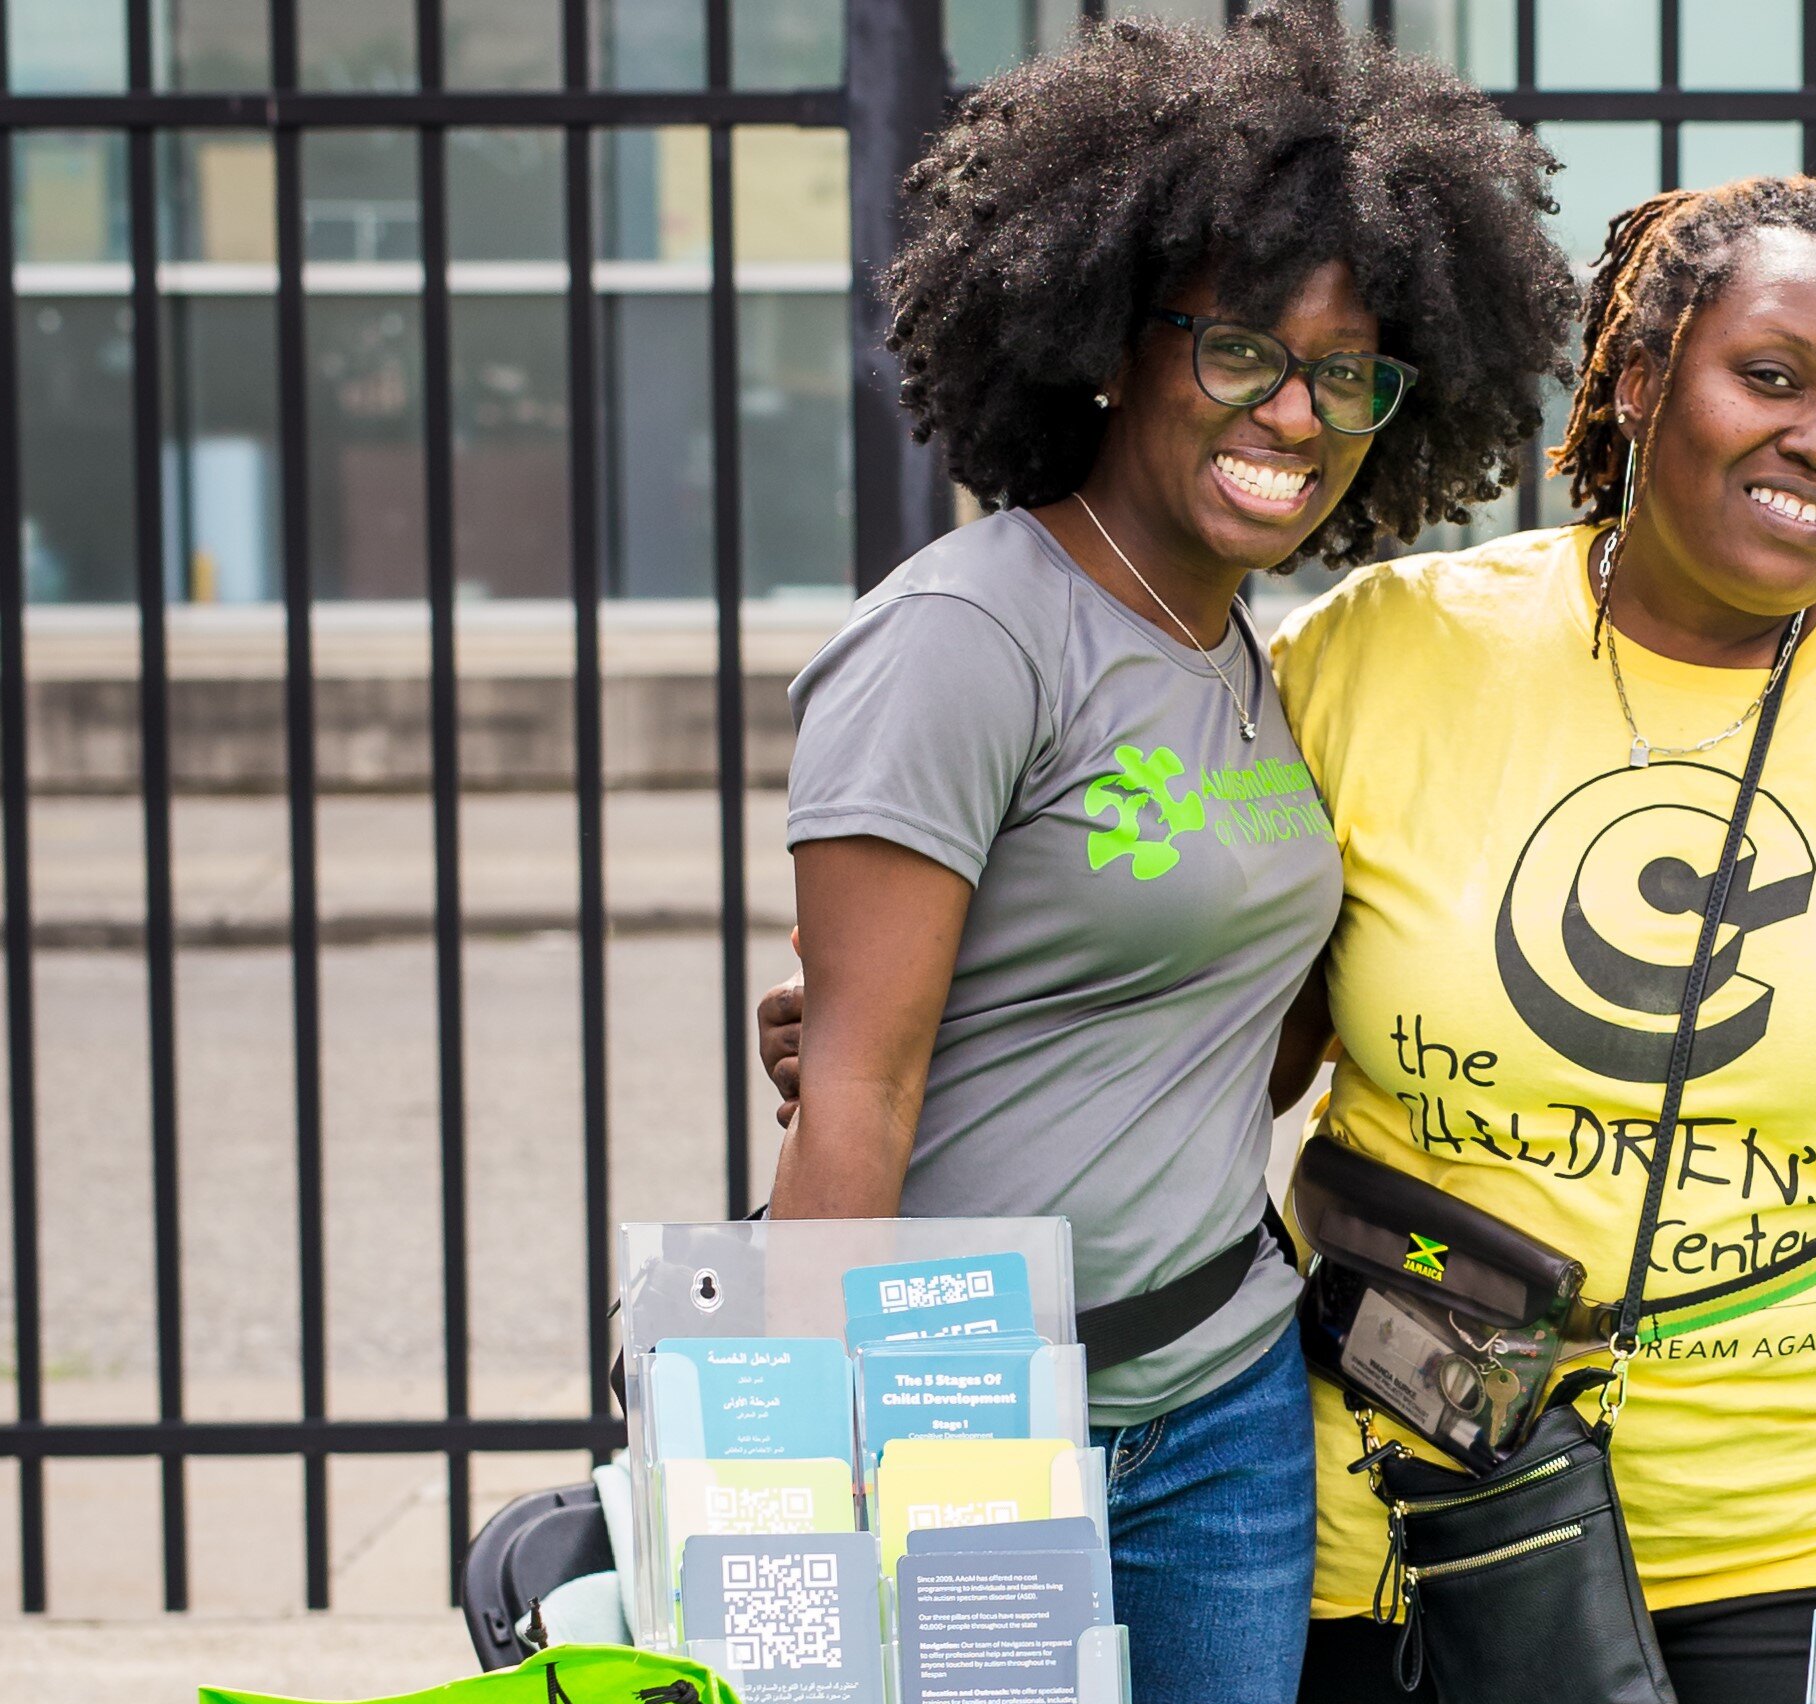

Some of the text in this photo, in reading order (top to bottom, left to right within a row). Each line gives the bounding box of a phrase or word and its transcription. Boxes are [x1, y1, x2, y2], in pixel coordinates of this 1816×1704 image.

[1390, 1014, 1498, 1087] the
[1403, 1258, 1443, 1283] JAMAICA
[1640, 1338, 1739, 1360] REAM
[894, 1373, 1002, 1389] The 5 Stages Of
[882, 1392, 1017, 1408] Child Development
[932, 1419, 969, 1432] Stage 1
